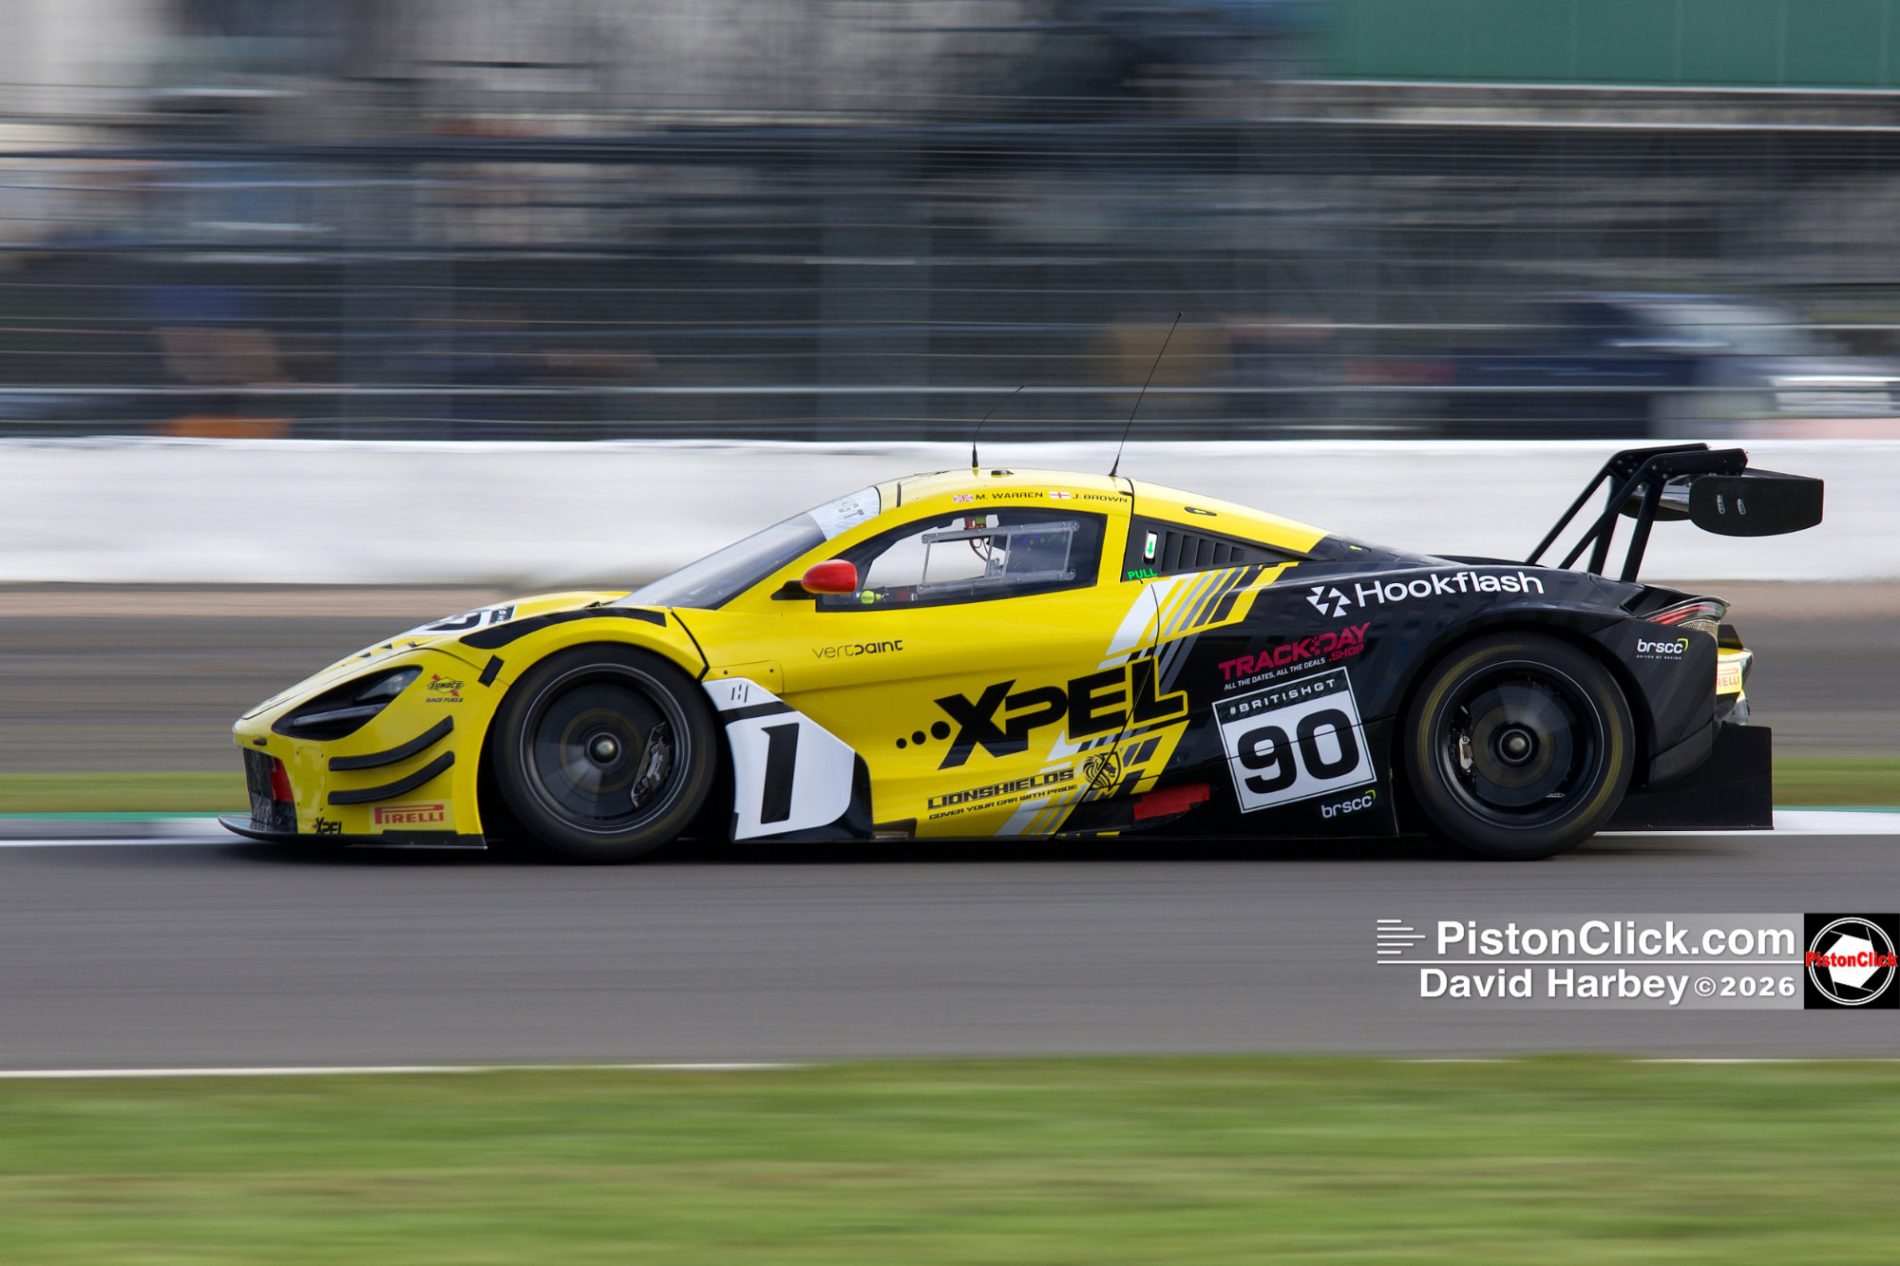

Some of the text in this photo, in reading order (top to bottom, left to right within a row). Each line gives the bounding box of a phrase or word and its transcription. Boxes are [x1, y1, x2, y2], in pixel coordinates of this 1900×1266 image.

[975, 491, 1043, 501] M. WARREN
[1083, 493, 1128, 503] BROWN
[1127, 567, 1158, 580] PULL
[1354, 571, 1544, 607] Hookflash
[812, 639, 904, 659] vertpaint
[1636, 638, 1684, 654] brscc
[427, 681, 464, 690] SUNOCO
[1224, 657, 1326, 691] ALL THE DATES, ALL THE DEALS
[1229, 679, 1336, 715] #BRITISHGT
[933, 658, 1185, 771] XPEL
[1237, 708, 1360, 794] 90
[760, 722, 800, 825] 1
[927, 767, 1075, 810] LIONSHIELDS
[929, 784, 1078, 820] COVER YOUR CAR WITH PRIDE
[374, 804, 444, 825] PIRELLI
[1321, 795, 1374, 818] brscc
